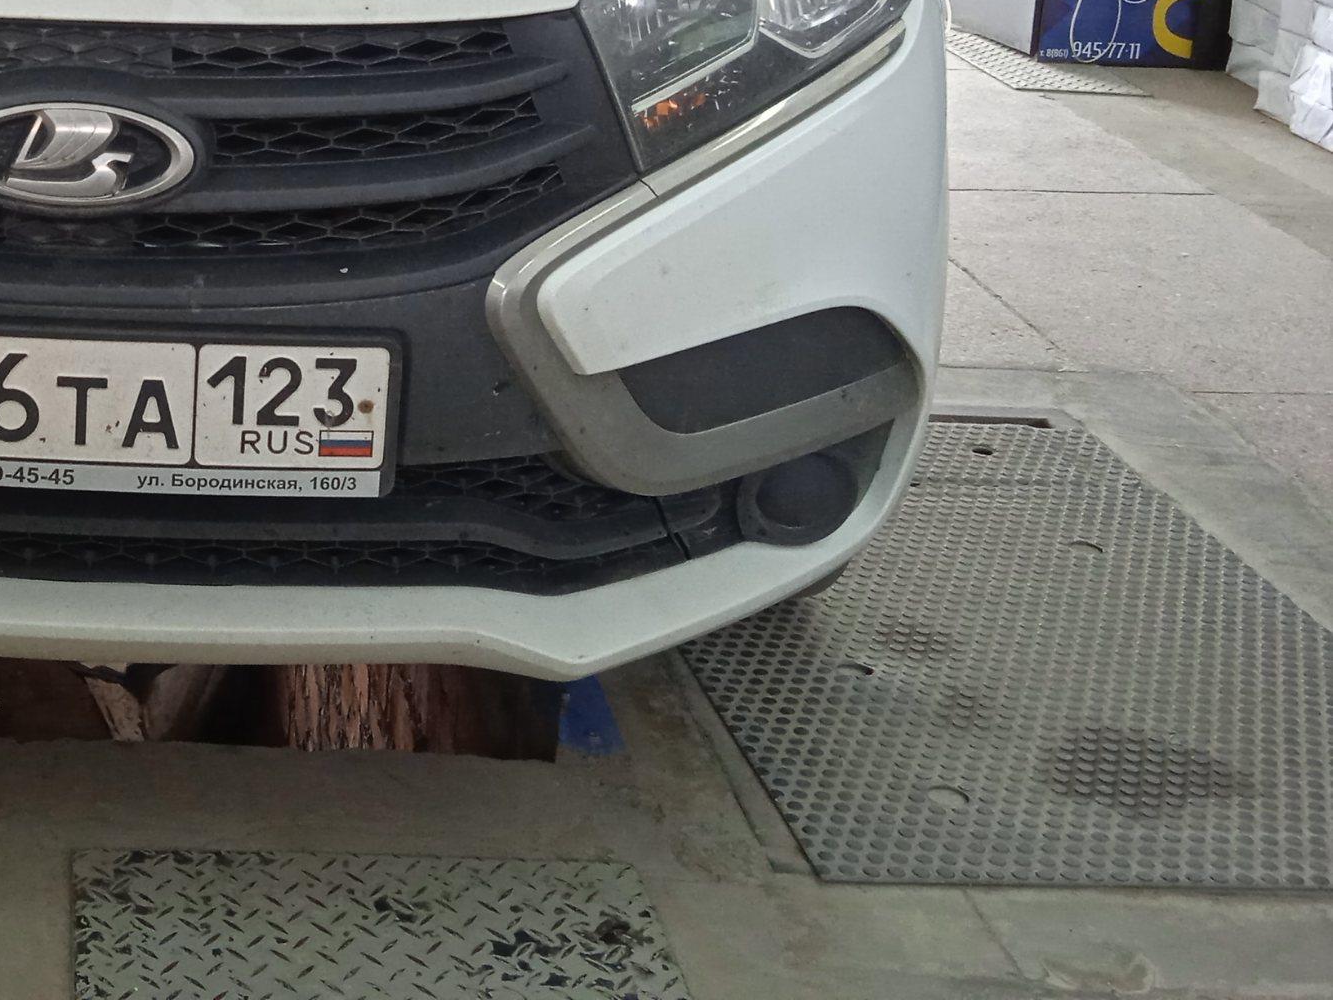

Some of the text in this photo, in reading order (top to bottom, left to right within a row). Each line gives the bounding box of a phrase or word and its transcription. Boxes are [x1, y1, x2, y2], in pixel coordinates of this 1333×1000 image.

[207, 356, 357, 428] 123
[240, 431, 314, 455] RUS
[137, 474, 357, 492] ул. Бородинская, 160/3
